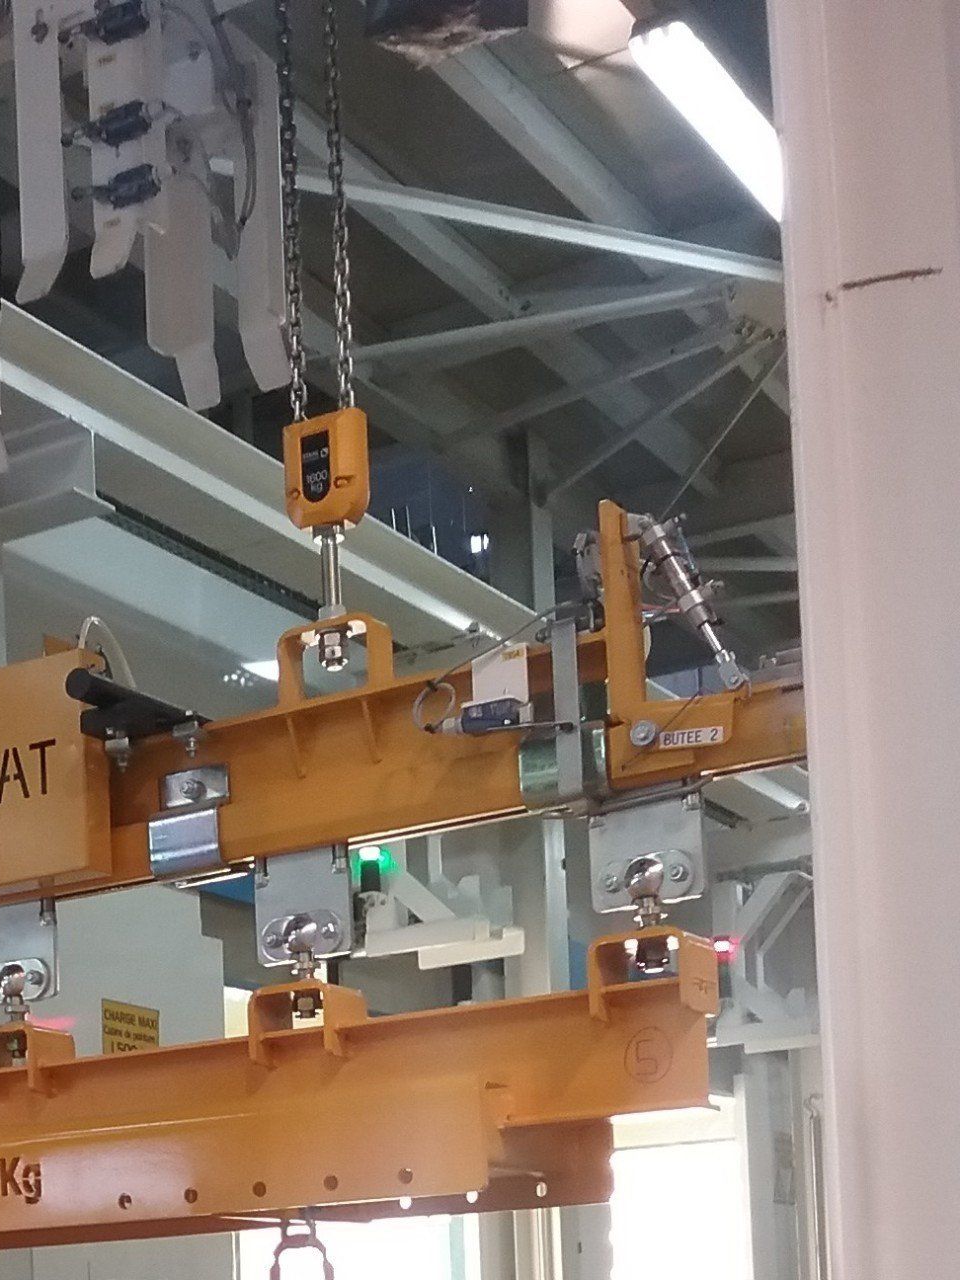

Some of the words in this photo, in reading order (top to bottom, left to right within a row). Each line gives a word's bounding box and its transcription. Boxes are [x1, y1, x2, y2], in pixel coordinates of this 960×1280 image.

[663, 730, 702, 746] BUTEE
[710, 728, 719, 741] 2
[103, 1008, 136, 1026] CHARGE
[0, 1156, 42, 1205] Kg
